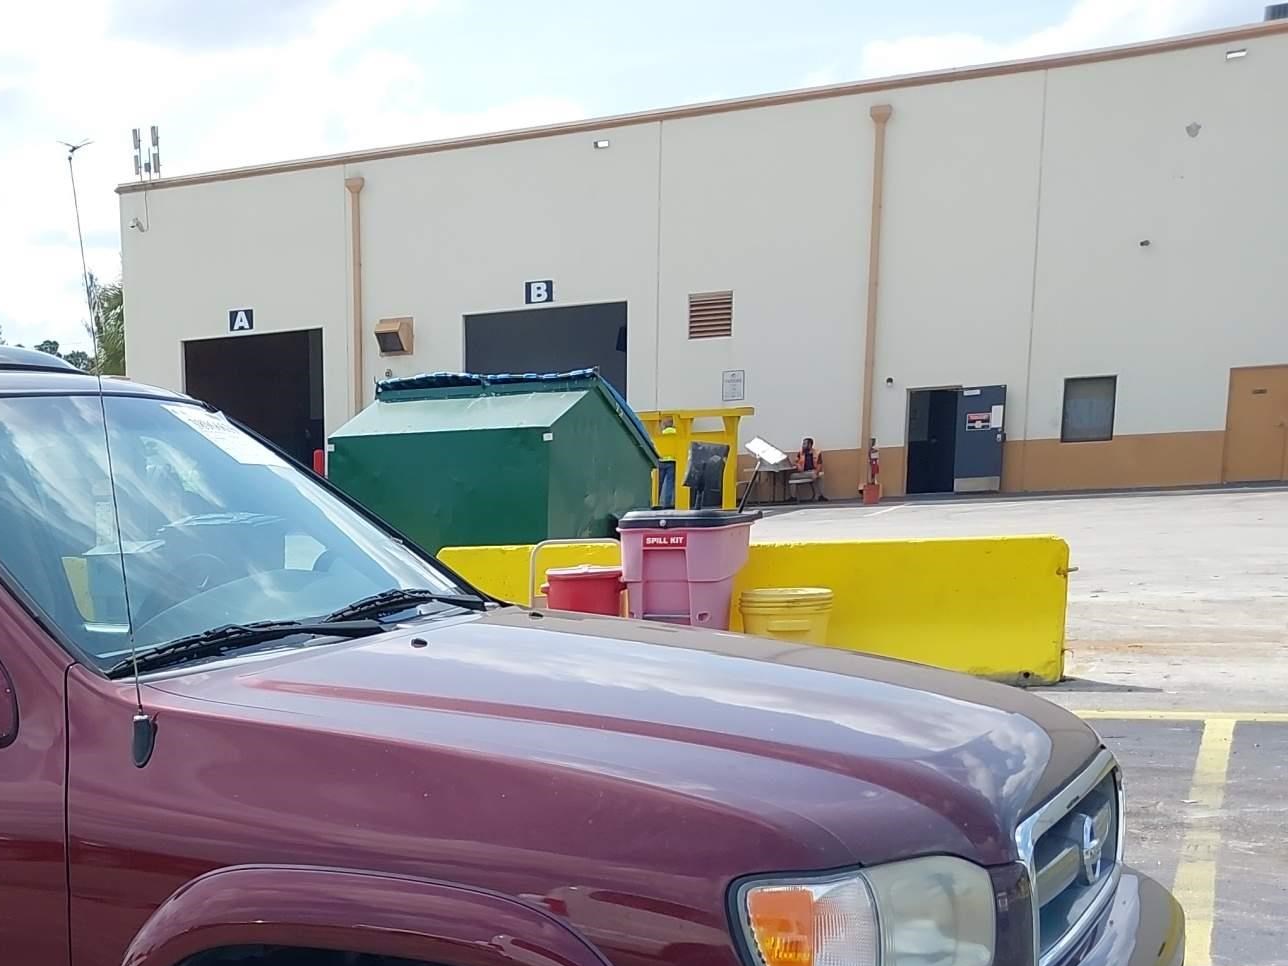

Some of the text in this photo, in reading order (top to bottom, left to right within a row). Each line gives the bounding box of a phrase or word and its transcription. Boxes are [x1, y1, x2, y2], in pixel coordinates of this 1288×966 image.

[531, 282, 548, 302] B
[233, 311, 250, 329] A
[670, 536, 684, 544] KIT
